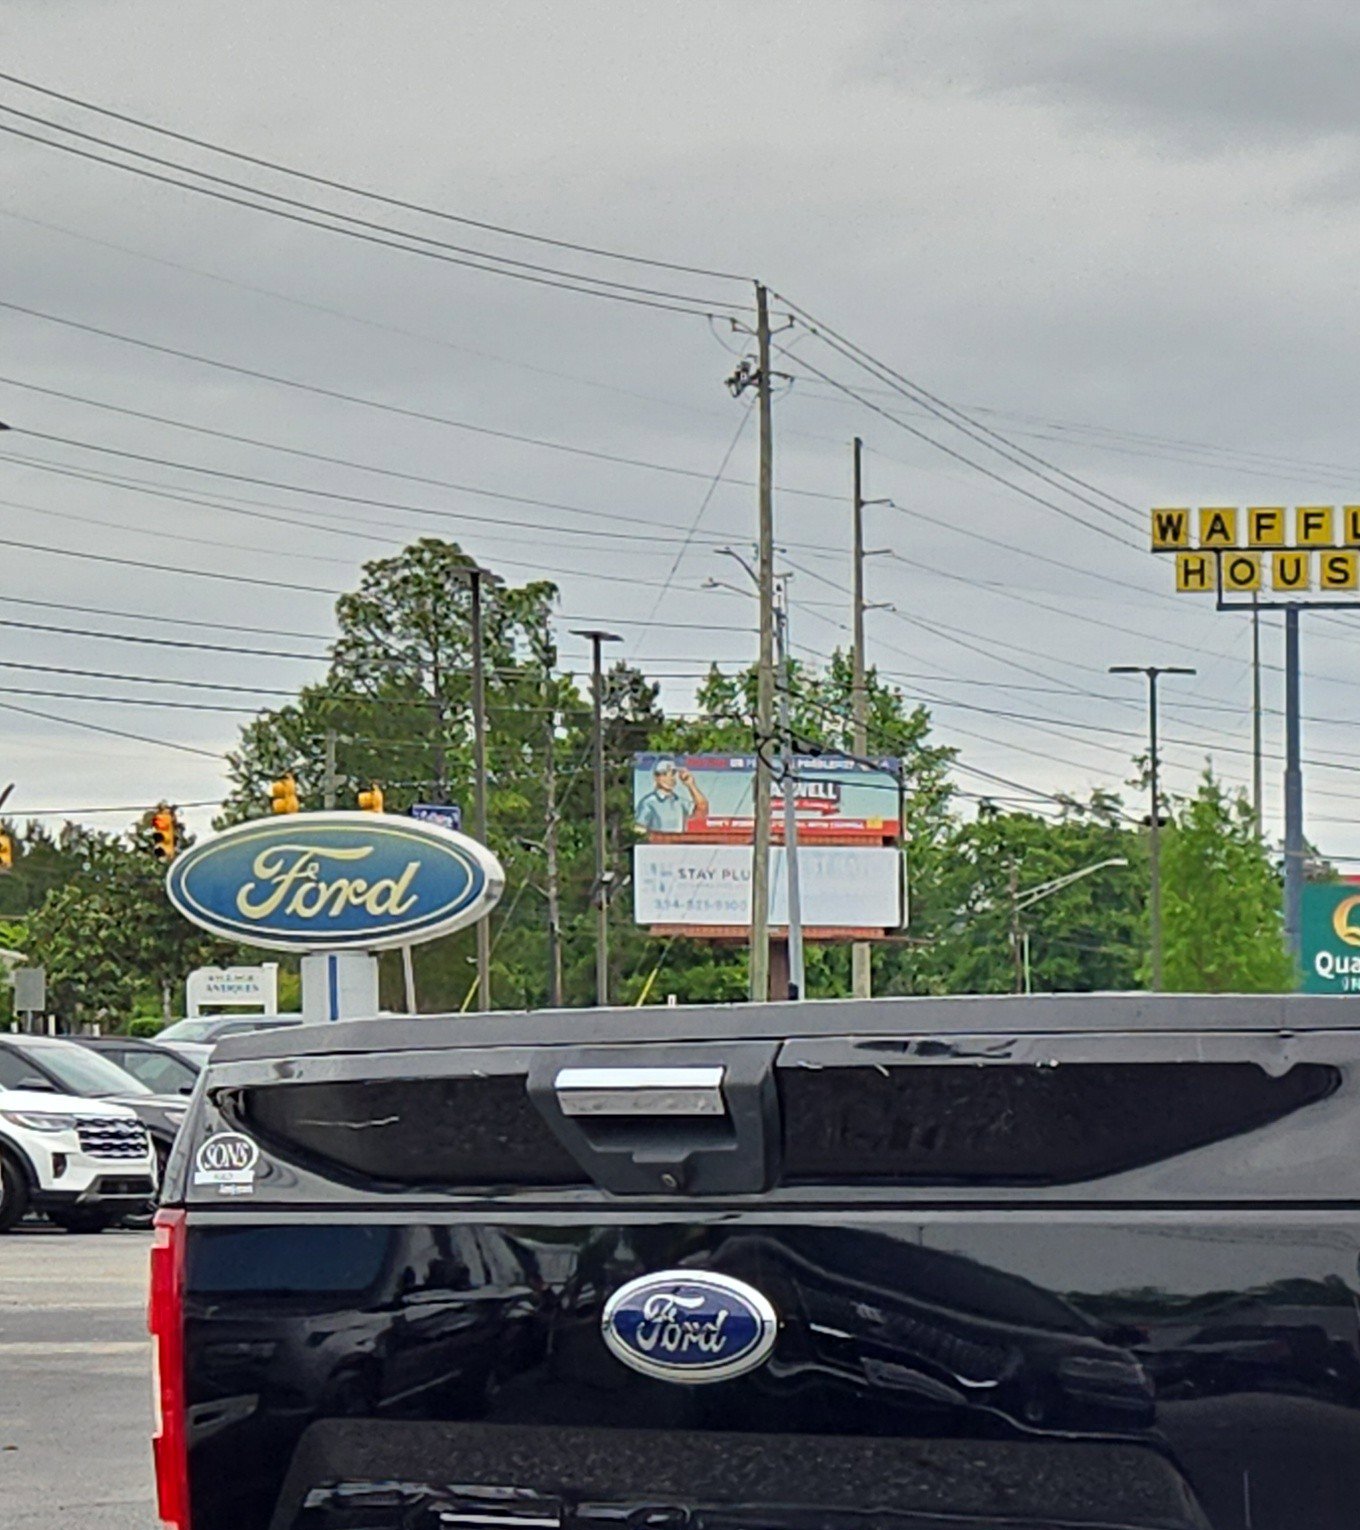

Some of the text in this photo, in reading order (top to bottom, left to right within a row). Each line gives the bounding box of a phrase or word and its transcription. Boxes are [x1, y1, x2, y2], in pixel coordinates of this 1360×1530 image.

[236, 844, 421, 919] Ford
[678, 867, 715, 880] STAY
[204, 1142, 250, 1168] SONS
[635, 1293, 729, 1353] Ford
